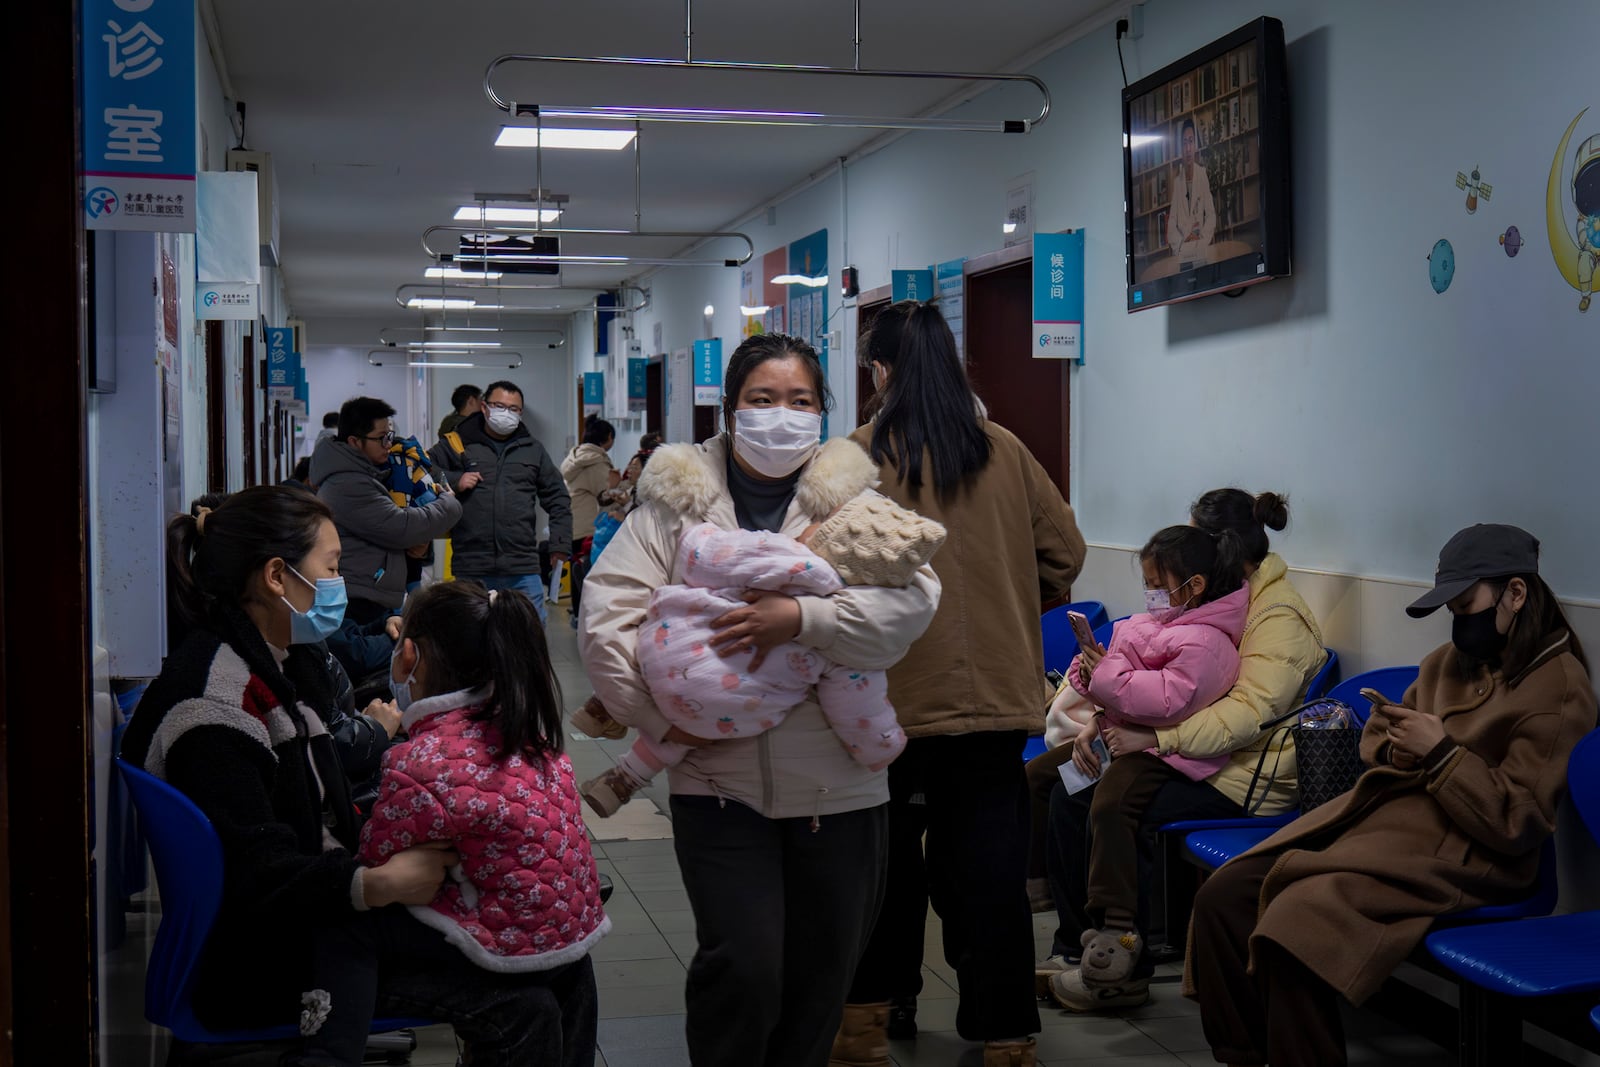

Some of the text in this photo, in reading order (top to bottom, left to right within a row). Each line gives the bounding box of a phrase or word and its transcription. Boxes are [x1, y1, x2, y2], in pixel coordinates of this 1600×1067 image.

[102, 0, 164, 163] 诊室
[124, 203, 184, 215] 附属儿童医院
[1050, 252, 1064, 299] 候诊间
[271, 330, 286, 384] 2诊室
